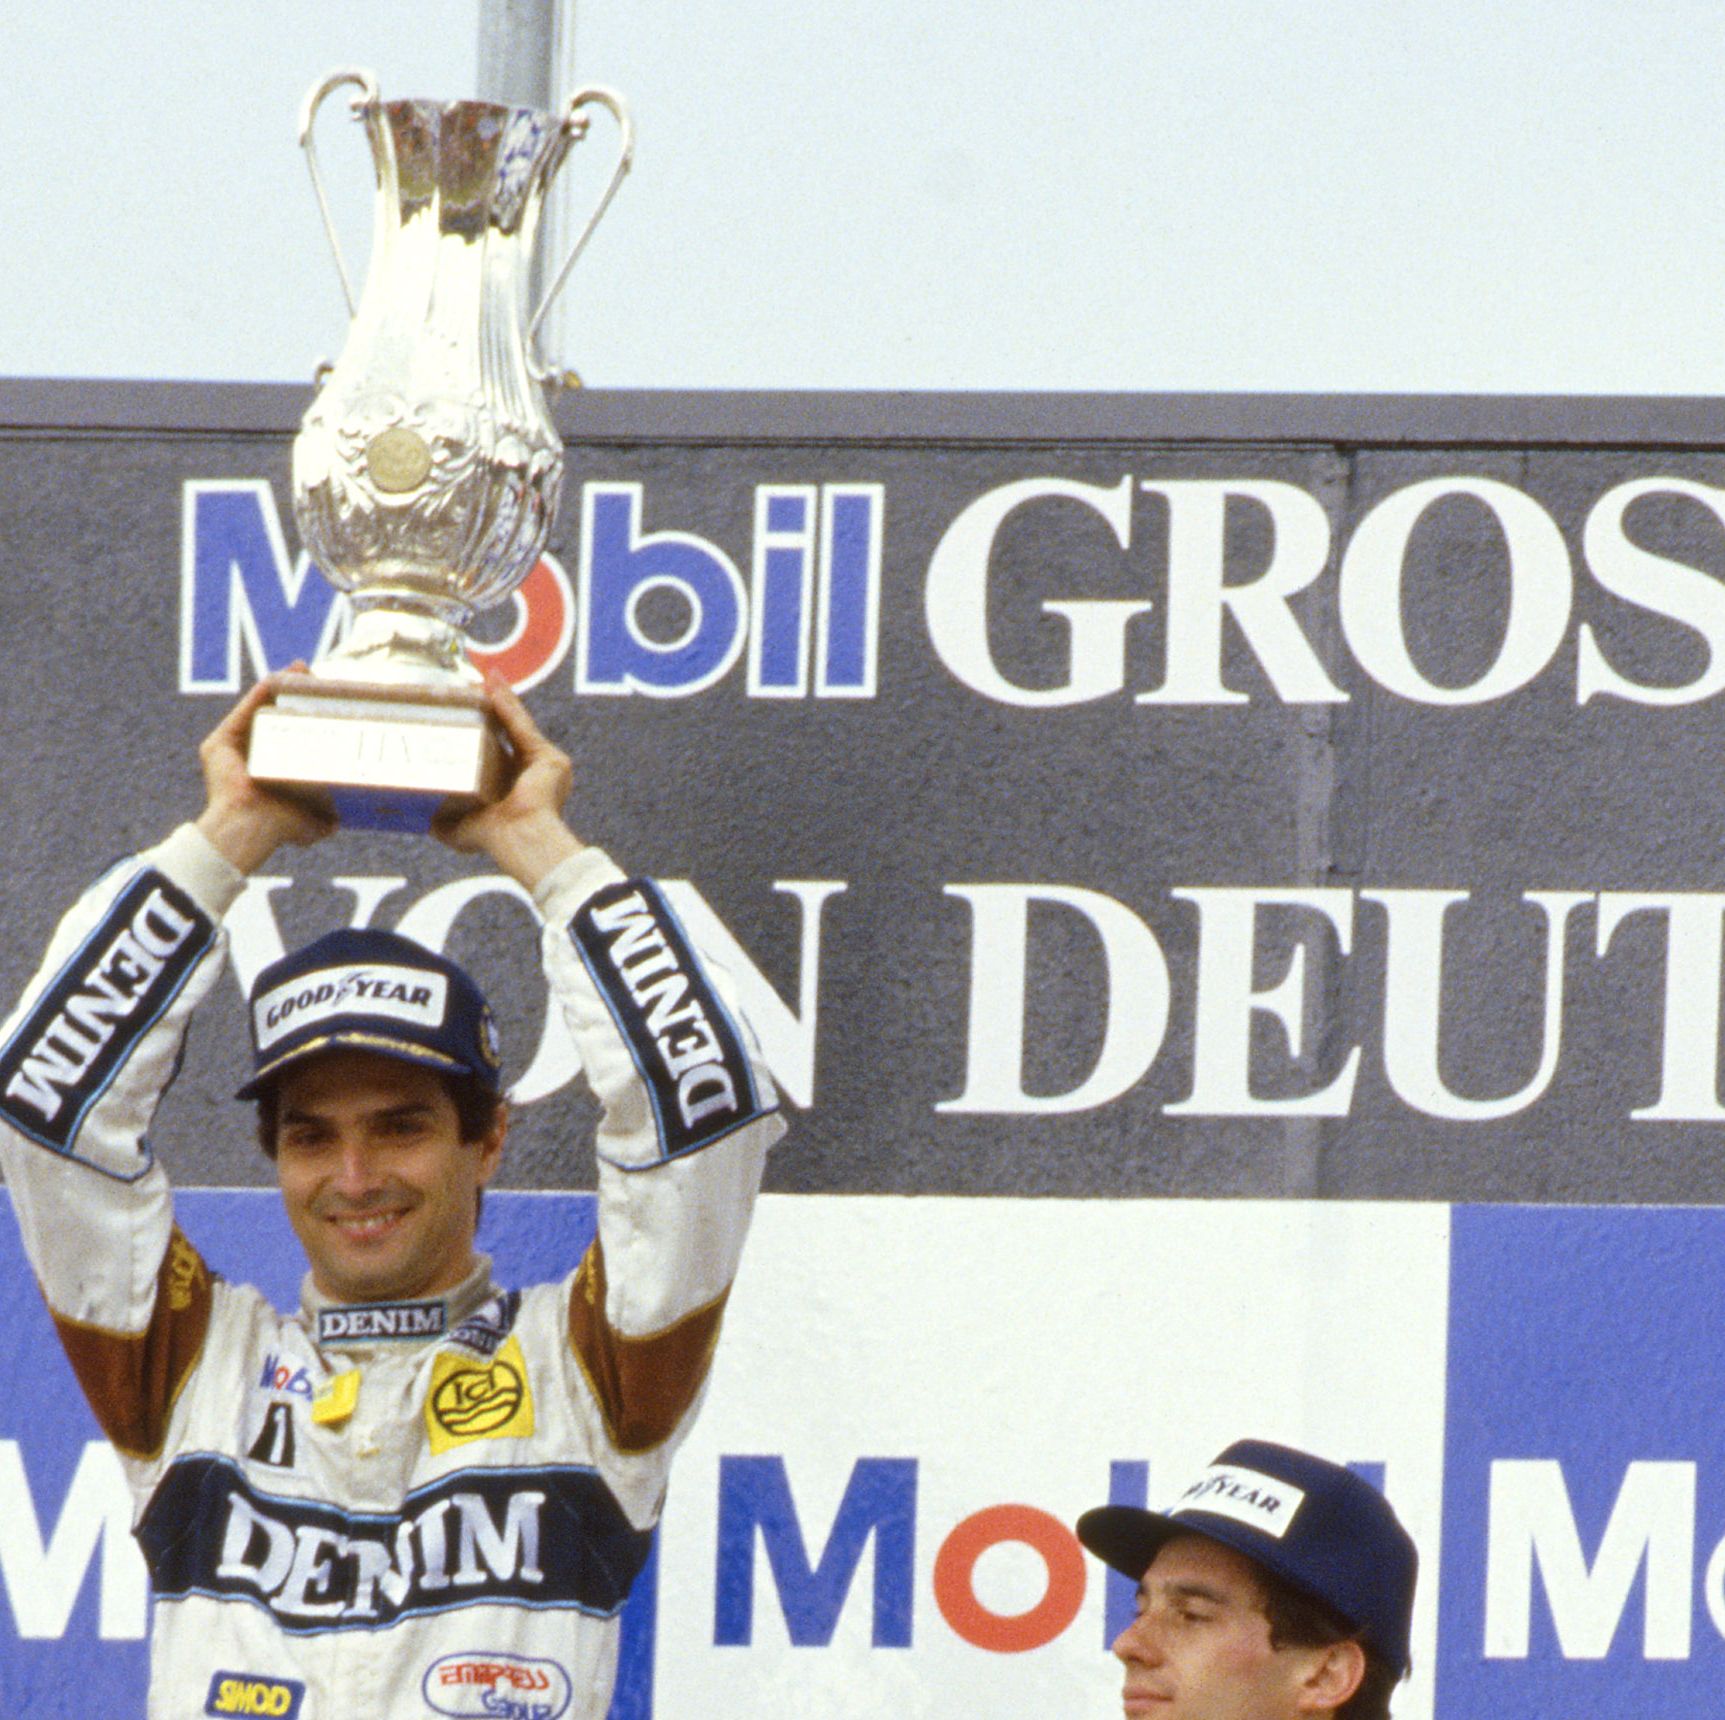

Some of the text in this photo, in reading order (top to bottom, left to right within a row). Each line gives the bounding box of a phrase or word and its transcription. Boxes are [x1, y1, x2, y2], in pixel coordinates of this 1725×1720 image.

[3, 886, 198, 1124] DENIM
[588, 890, 741, 1129] DENIM
[260, 1353, 313, 1403] Mob
[322, 1307, 444, 1339] DENIM
[216, 1490, 546, 1620] DENIM
